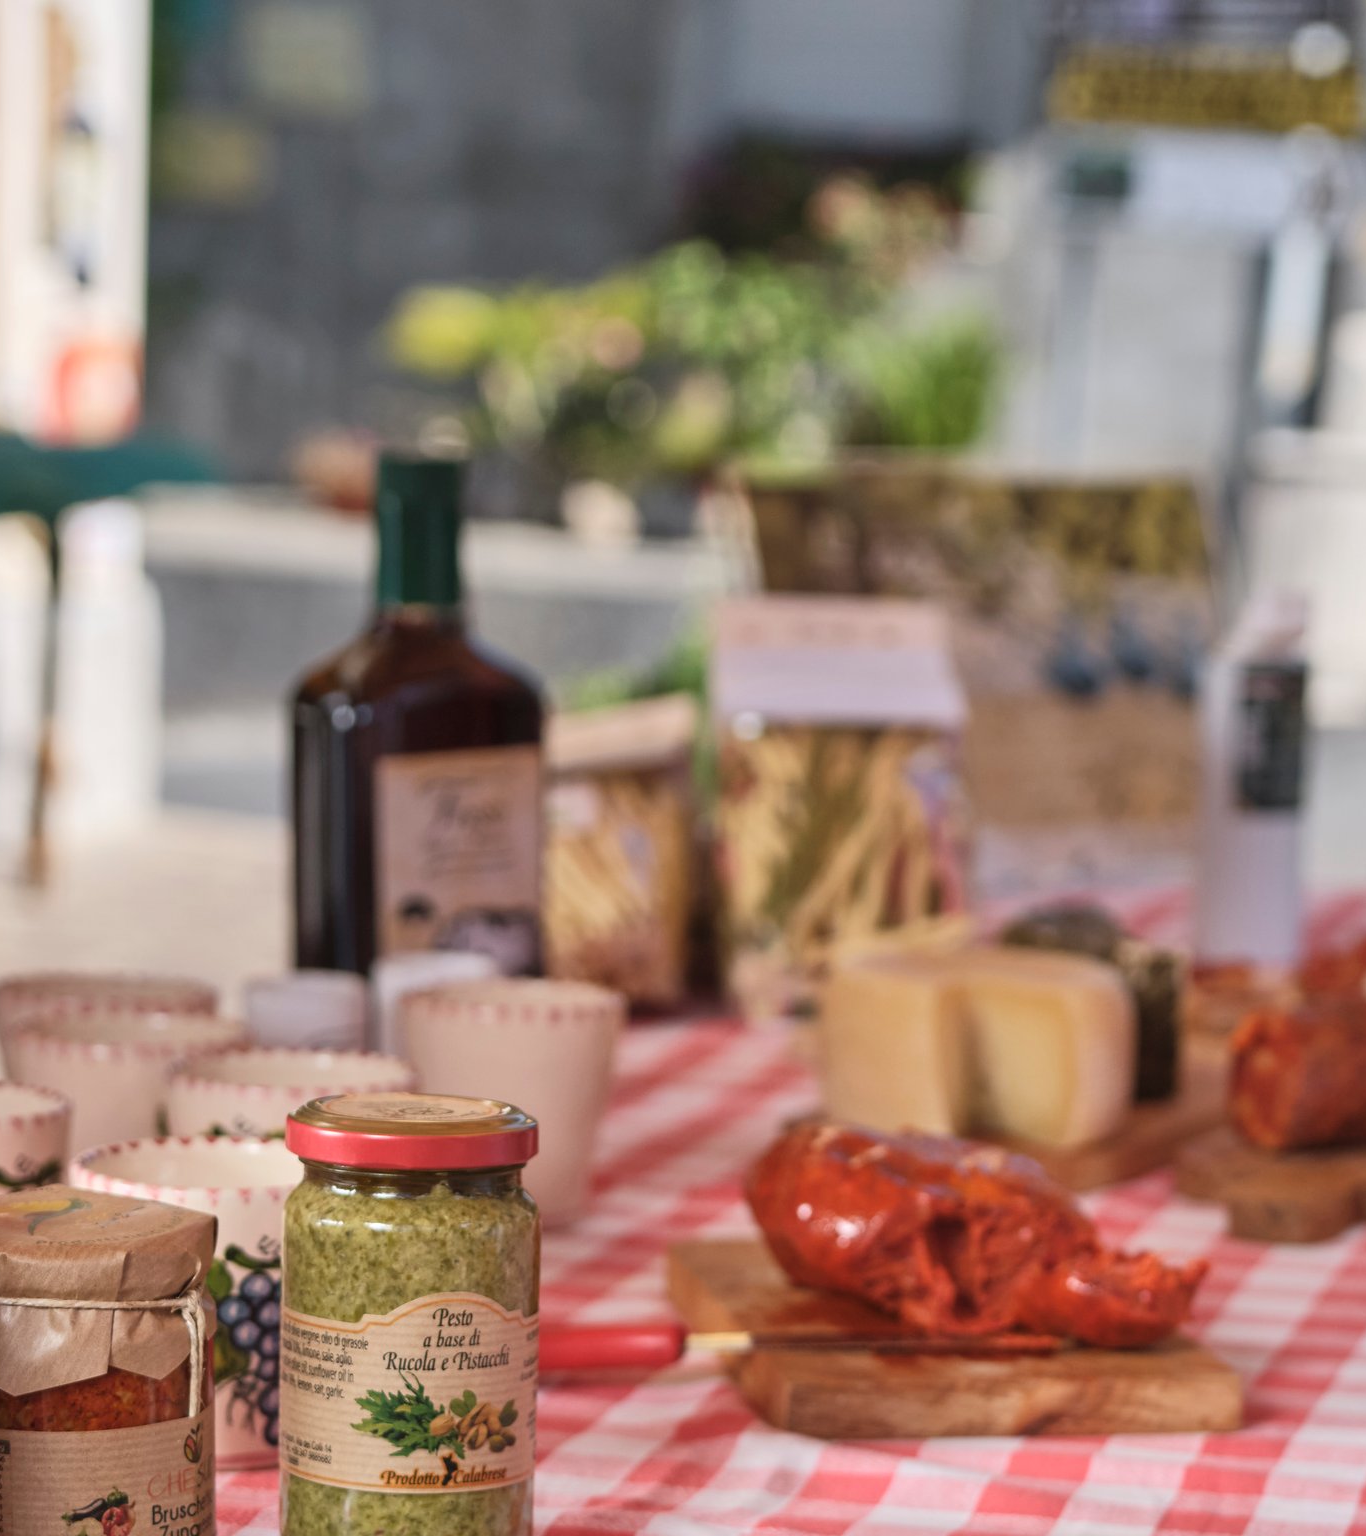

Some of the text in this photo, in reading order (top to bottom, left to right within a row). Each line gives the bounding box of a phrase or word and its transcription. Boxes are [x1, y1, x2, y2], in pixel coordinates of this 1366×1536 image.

[432, 1308, 473, 1327] Pesto
[341, 1333, 369, 1351] girasole
[423, 1327, 482, 1348] a base di
[383, 1350, 436, 1371] Rucola
[441, 1356, 449, 1371] e
[453, 1343, 510, 1370] Pistacchi
[380, 1465, 507, 1486] Prodotto Calabrese
